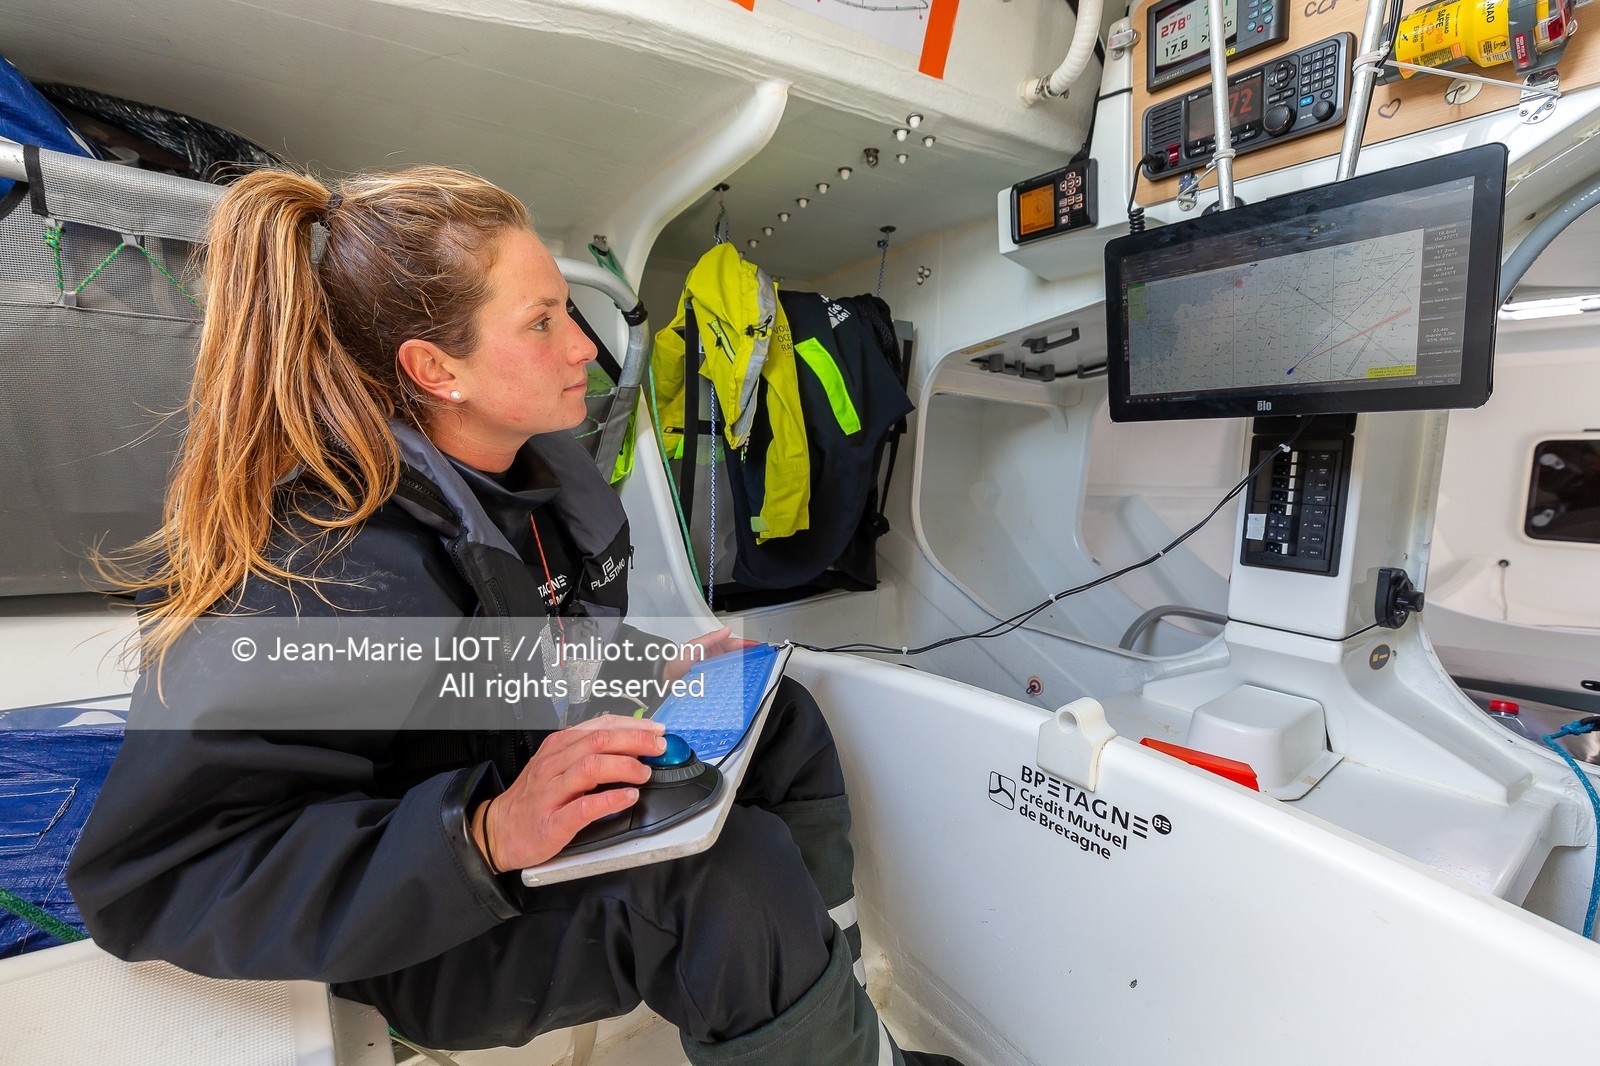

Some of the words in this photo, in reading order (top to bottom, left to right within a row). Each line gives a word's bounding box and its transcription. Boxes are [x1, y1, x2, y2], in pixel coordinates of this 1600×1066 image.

[1165, 39, 1188, 58] 17.8
[590, 558, 626, 591] PLASTIMO
[1019, 787, 1065, 819] Crédit
[1067, 810, 1128, 851] Mutuel
[1020, 765, 1149, 840] BRETAGNE
[1018, 804, 1037, 822] de
[1039, 815, 1112, 861] Bretagne
